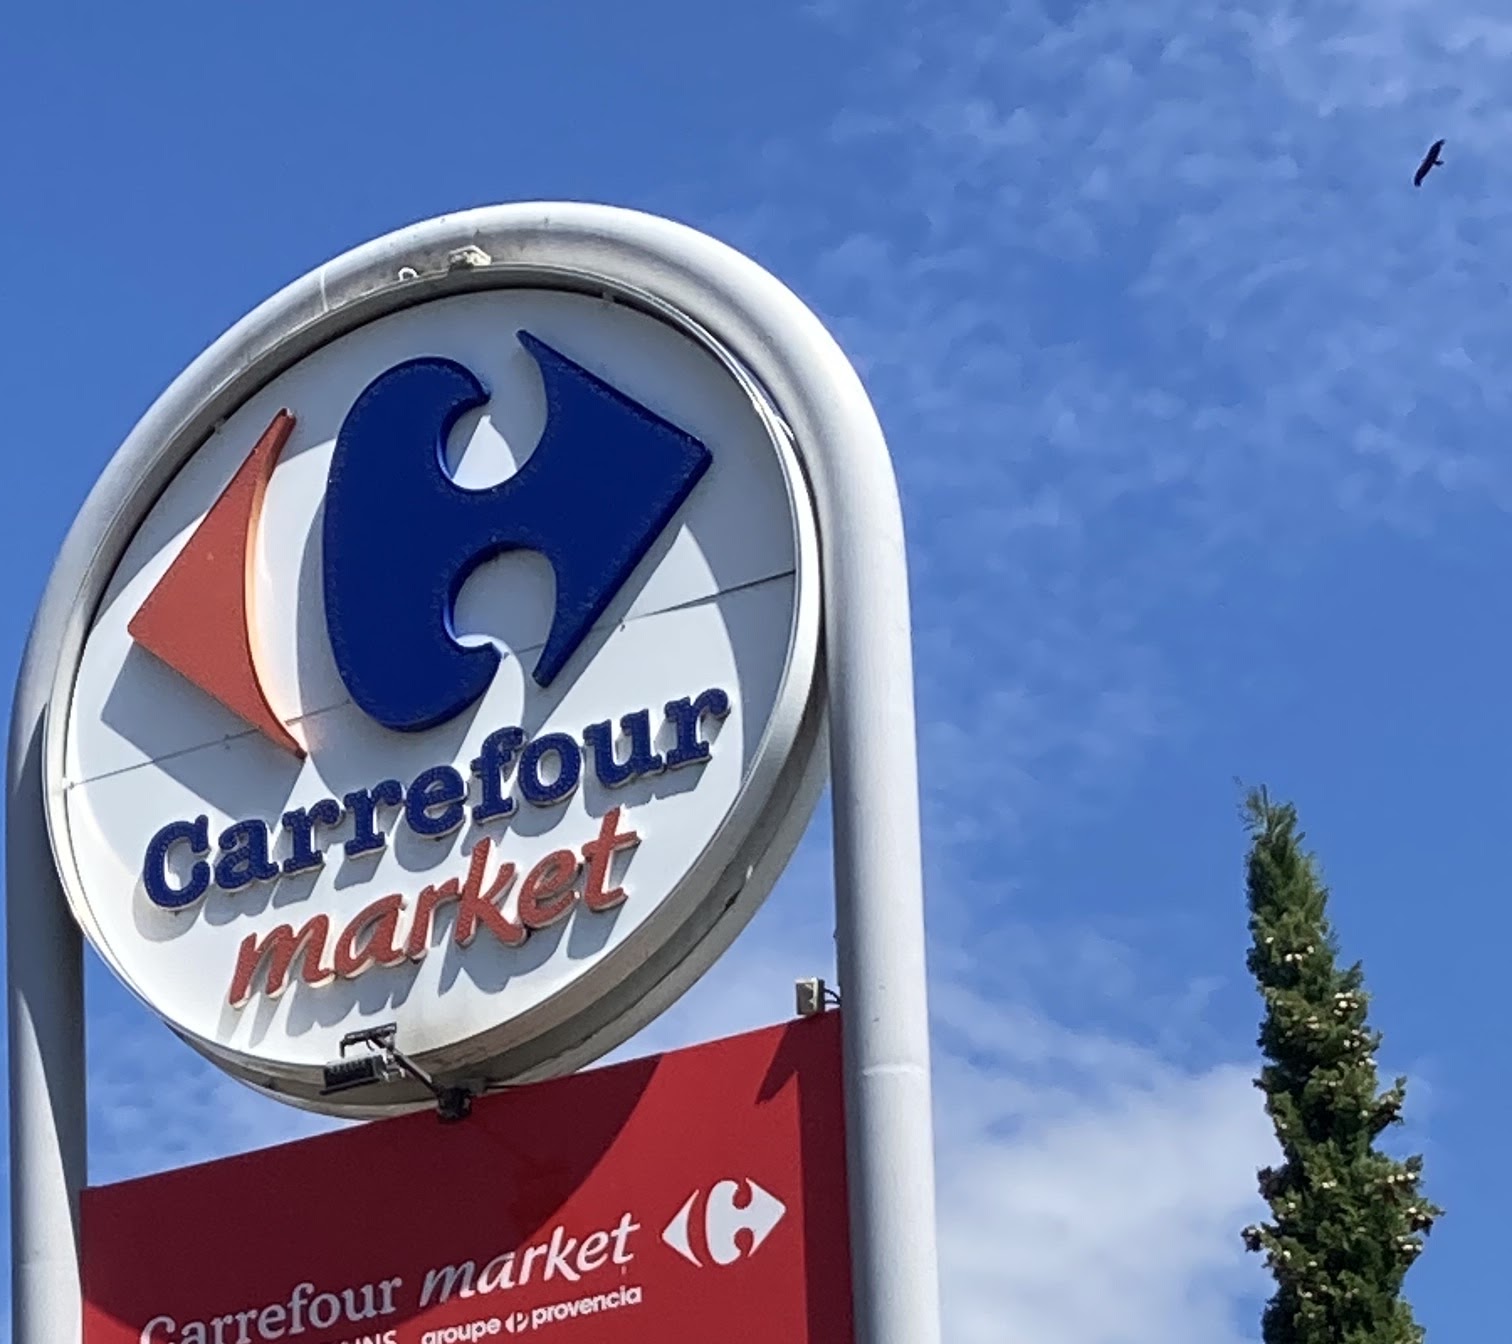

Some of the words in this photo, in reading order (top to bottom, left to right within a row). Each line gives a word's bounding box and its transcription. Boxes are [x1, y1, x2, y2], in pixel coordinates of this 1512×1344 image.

[143, 687, 731, 912] Carrefour
[228, 806, 640, 1008] market
[419, 1212, 641, 1307] market
[531, 1284, 643, 1331] provencia
